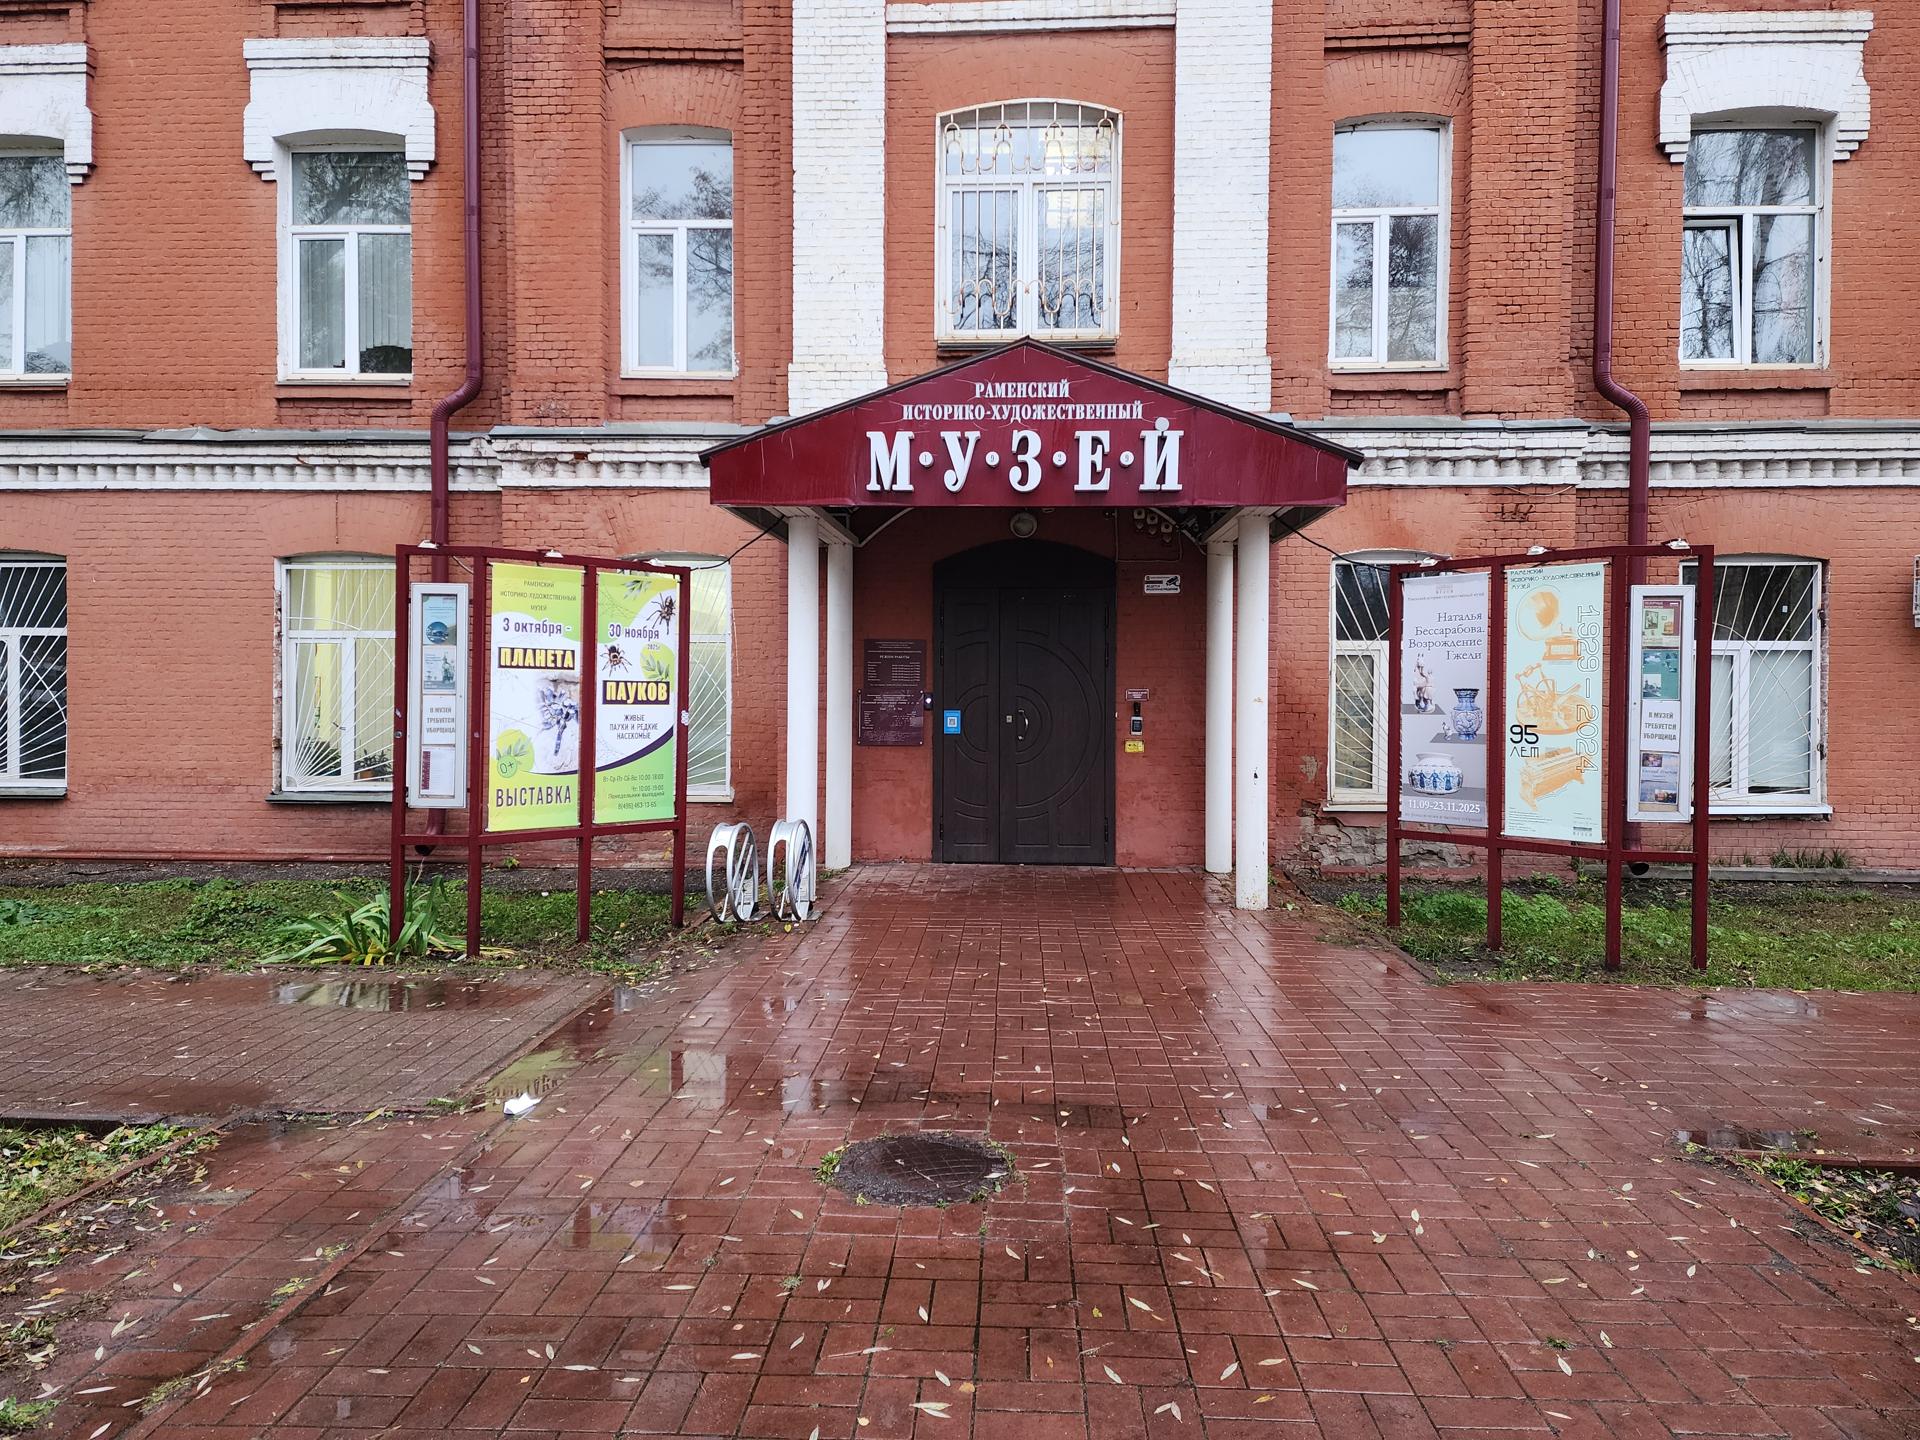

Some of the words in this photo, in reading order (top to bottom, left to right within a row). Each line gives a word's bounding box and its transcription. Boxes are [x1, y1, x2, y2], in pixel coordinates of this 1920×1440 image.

[975, 379, 1070, 398] РАМЕНСКИЙ
[902, 400, 1143, 422] ИСТОРИКО-ХУДОЖЕСТВЕННЫЙ
[1437, 612, 1482, 623] Наталья
[503, 617, 510, 632] 3
[514, 619, 562, 637] октября
[609, 623, 621, 637] 30
[624, 625, 659, 641] ноября
[1415, 624, 1485, 638] Бессарабова.
[1408, 638, 1483, 651] Возрождение
[500, 647, 574, 668] ПЛАНЕТА
[1447, 650, 1482, 660] Гжели
[606, 681, 668, 704] ПАУКОВ
[1653, 711, 1673, 719] МУЗЕЙ
[609, 723, 629, 731] ПАУКИ
[636, 723, 658, 732] РЕДКИЕ
[1645, 722, 1677, 730] ТРЕБУЕТСЯ
[616, 732, 651, 740] НАСЕКОМЫЕ
[1510, 724, 1539, 744] 95
[500, 761, 514, 774] 0+
[496, 785, 571, 807] ВЫСТАВКА
[1409, 799, 1481, 814] 11.09-23.11.2025
